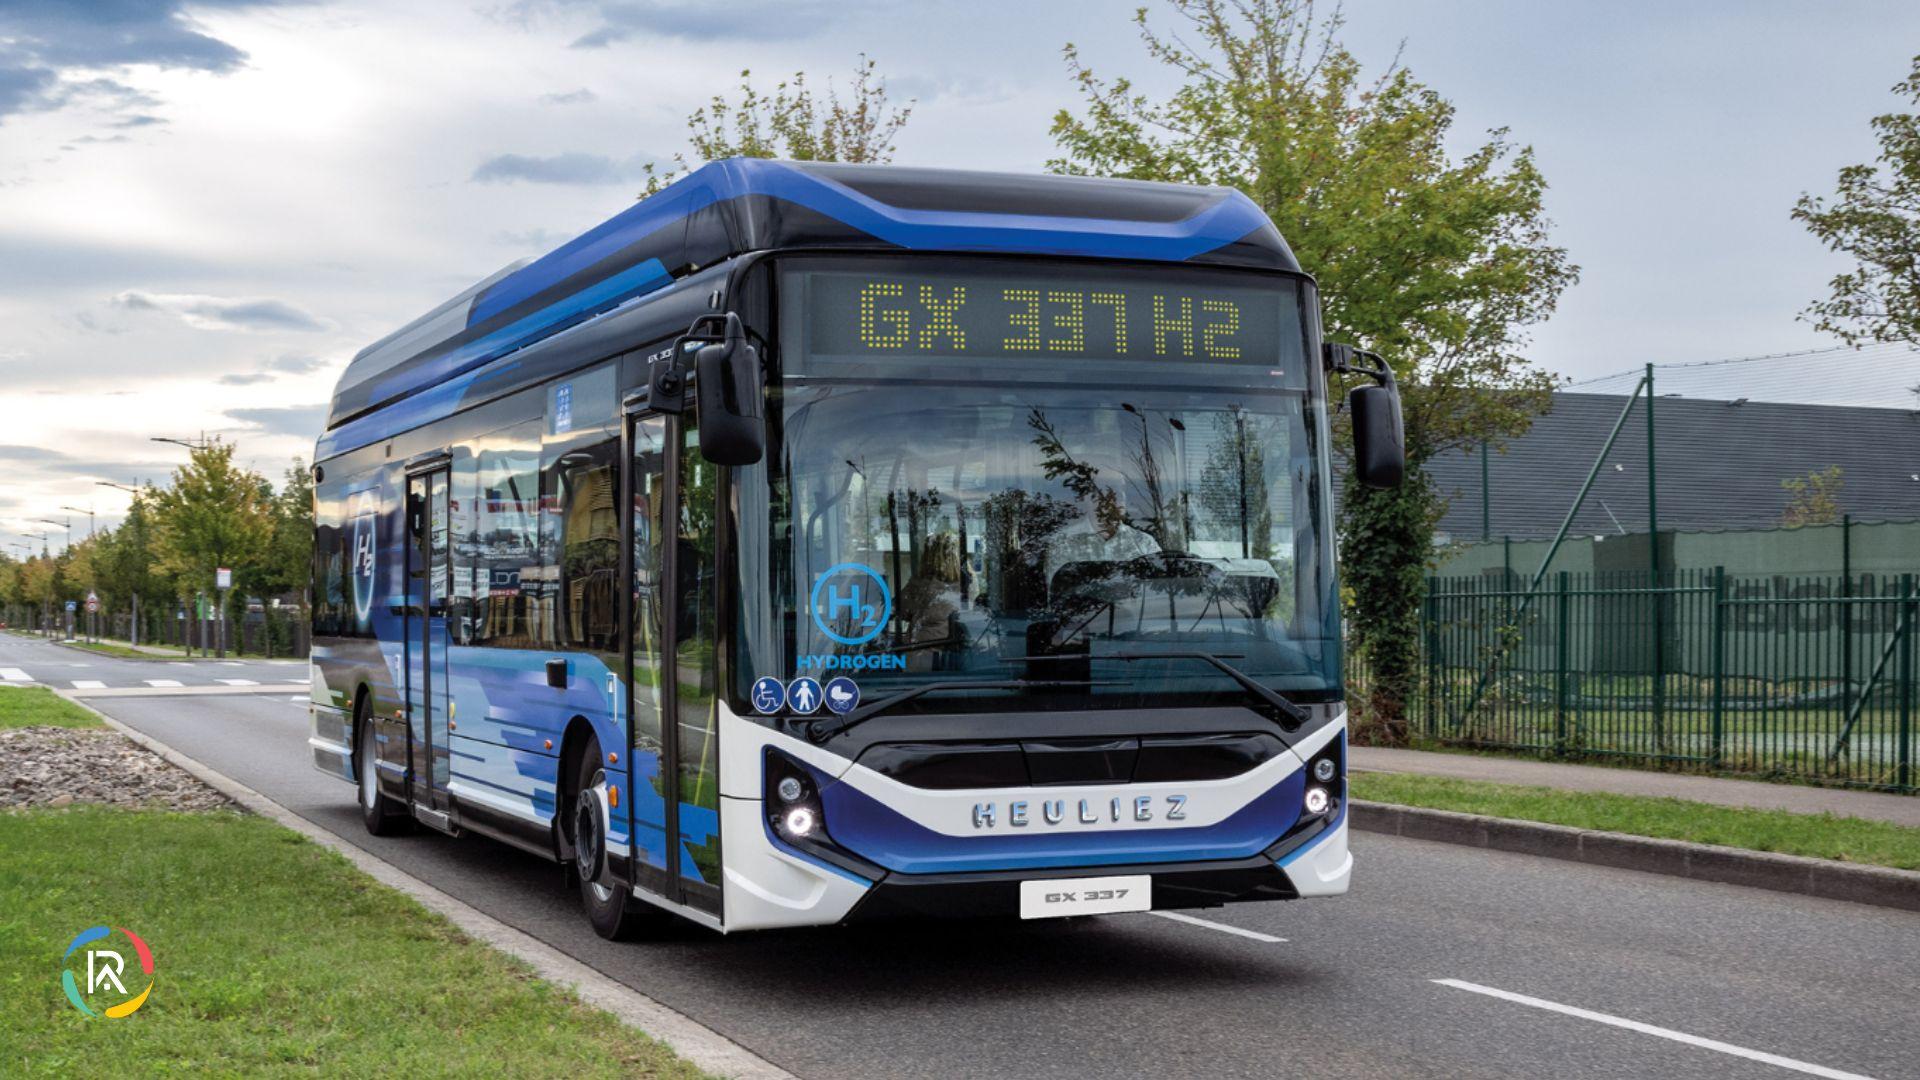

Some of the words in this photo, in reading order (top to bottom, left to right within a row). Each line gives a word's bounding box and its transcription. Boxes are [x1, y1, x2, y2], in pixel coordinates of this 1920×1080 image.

[861, 283, 966, 350] GX
[1003, 288, 1128, 354] 337
[1154, 294, 1240, 359] H2
[828, 584, 877, 627] H2
[797, 654, 907, 670] HYDROGEN
[973, 794, 1188, 828] HEULIEZ
[1045, 892, 1076, 903] GX
[1084, 889, 1129, 901] 337
